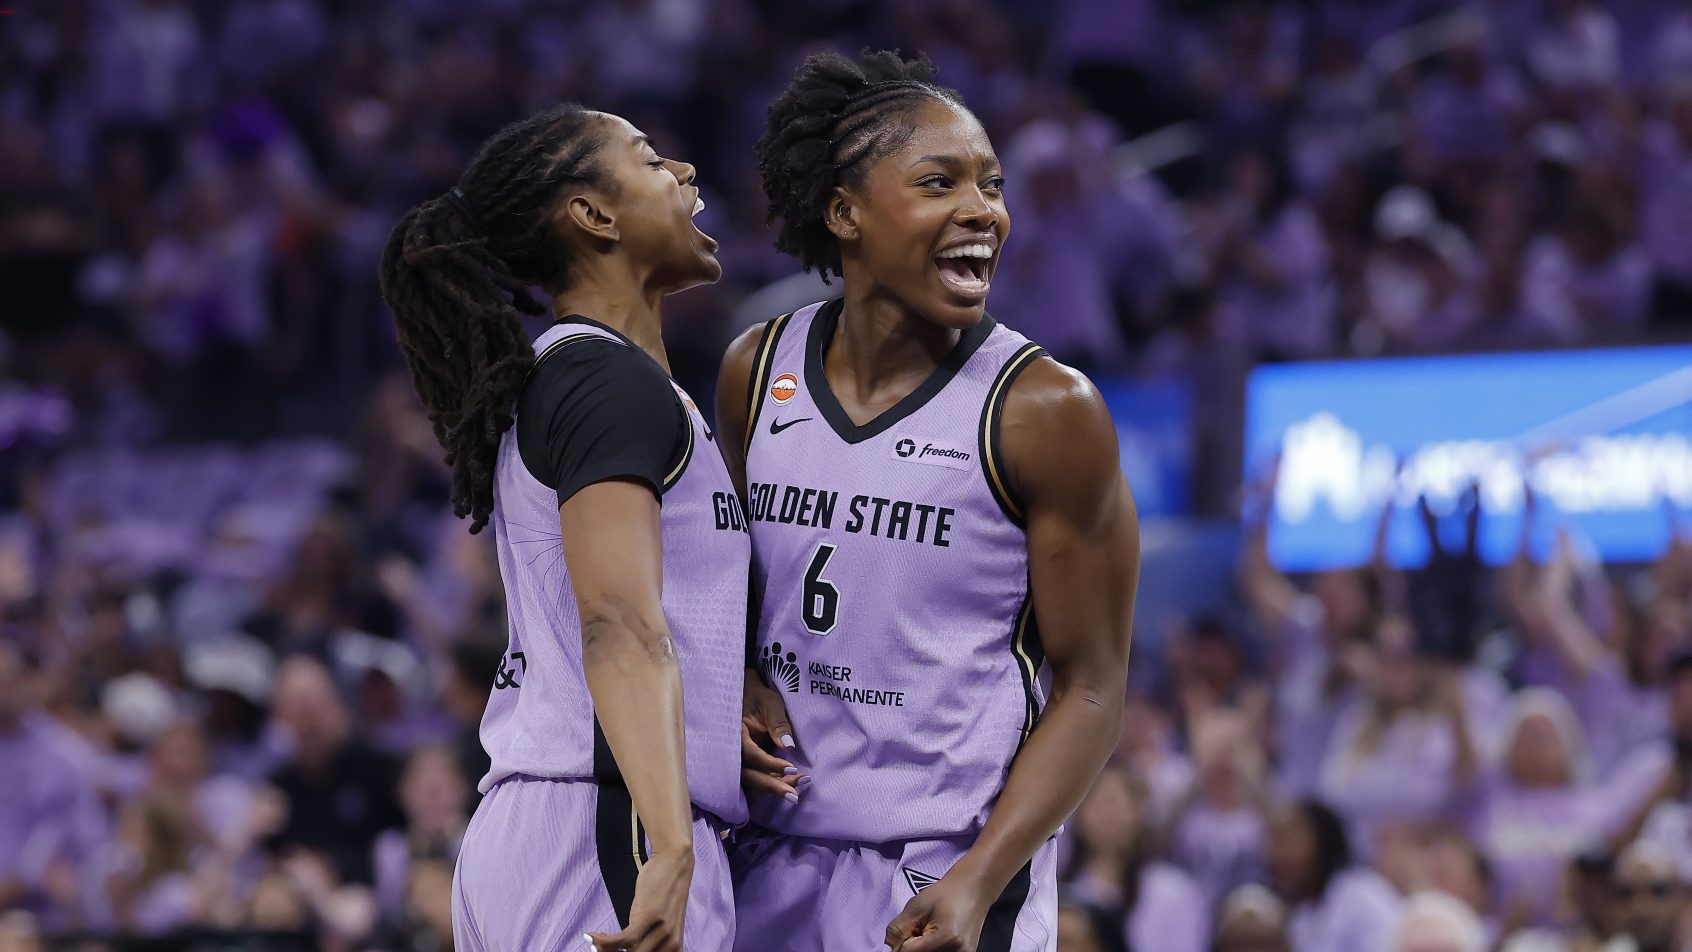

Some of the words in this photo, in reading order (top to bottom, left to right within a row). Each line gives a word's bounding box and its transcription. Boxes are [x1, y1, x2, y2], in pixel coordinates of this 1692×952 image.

[918, 443, 971, 461] freedom
[749, 482, 839, 530] GOLDEN
[844, 494, 955, 547] STATE
[801, 542, 841, 636] 6
[808, 660, 852, 682] KAISER
[810, 680, 905, 707] PERMANENTE
